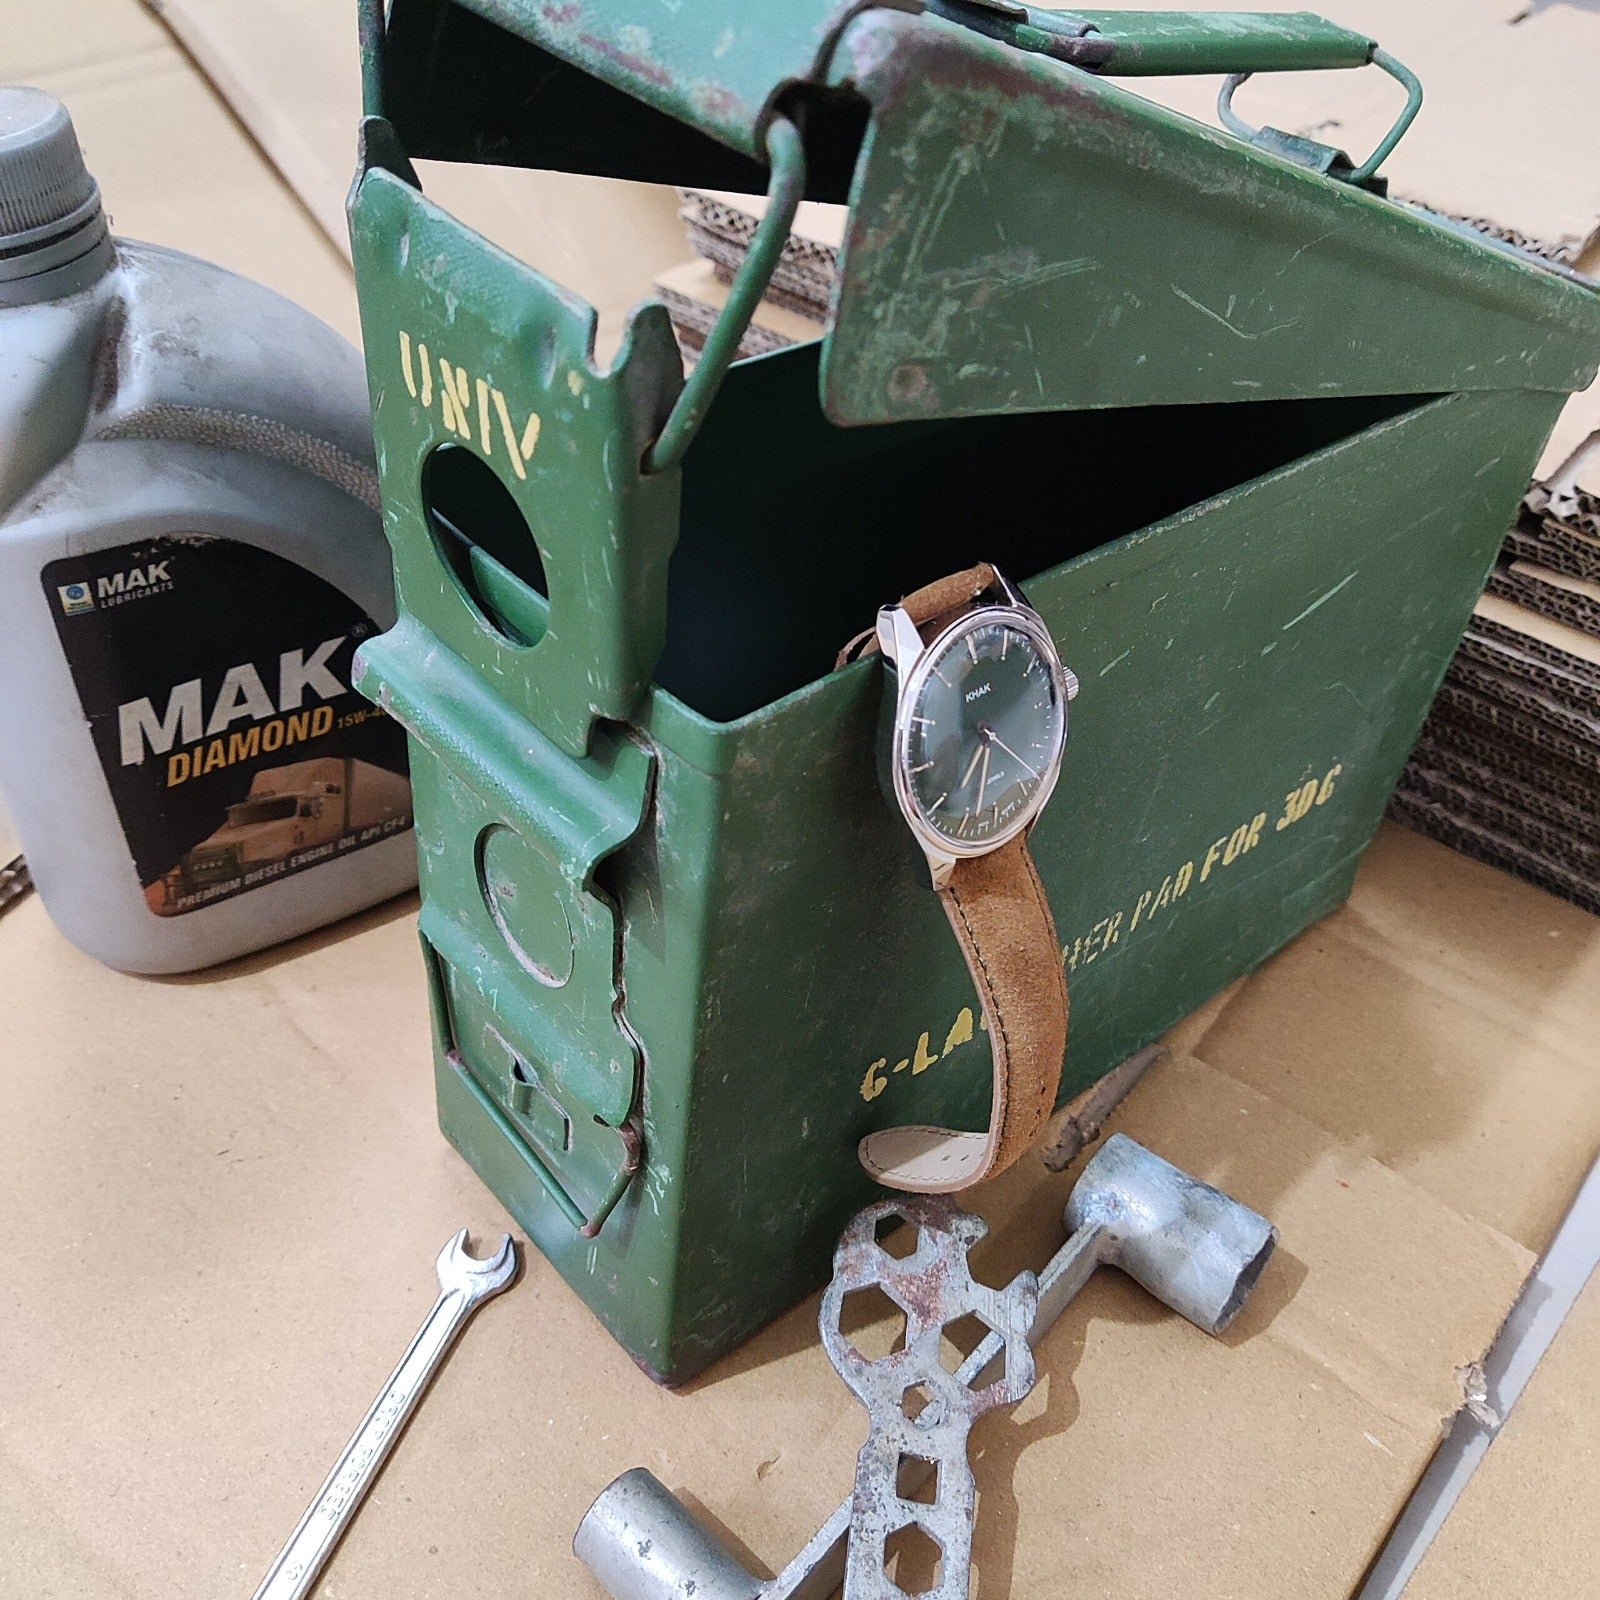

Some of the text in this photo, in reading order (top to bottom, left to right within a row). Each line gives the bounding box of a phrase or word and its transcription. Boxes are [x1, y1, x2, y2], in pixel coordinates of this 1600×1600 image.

[399, 330, 541, 480] UNIV
[97, 560, 172, 598] MAK
[100, 581, 175, 609] LUBRICANTS
[117, 636, 348, 767] MAK
[965, 682, 992, 703] KHAK
[167, 705, 386, 788] DIAMOND 15W-4
[177, 877, 241, 909] PREMIUM
[245, 864, 287, 885] DIESEL
[290, 843, 334, 867] ENGINE
[338, 835, 356, 850] OIL
[360, 825, 381, 842] API
[1130, 861, 1193, 932] PAD
[1200, 812, 1267, 883] FOR
